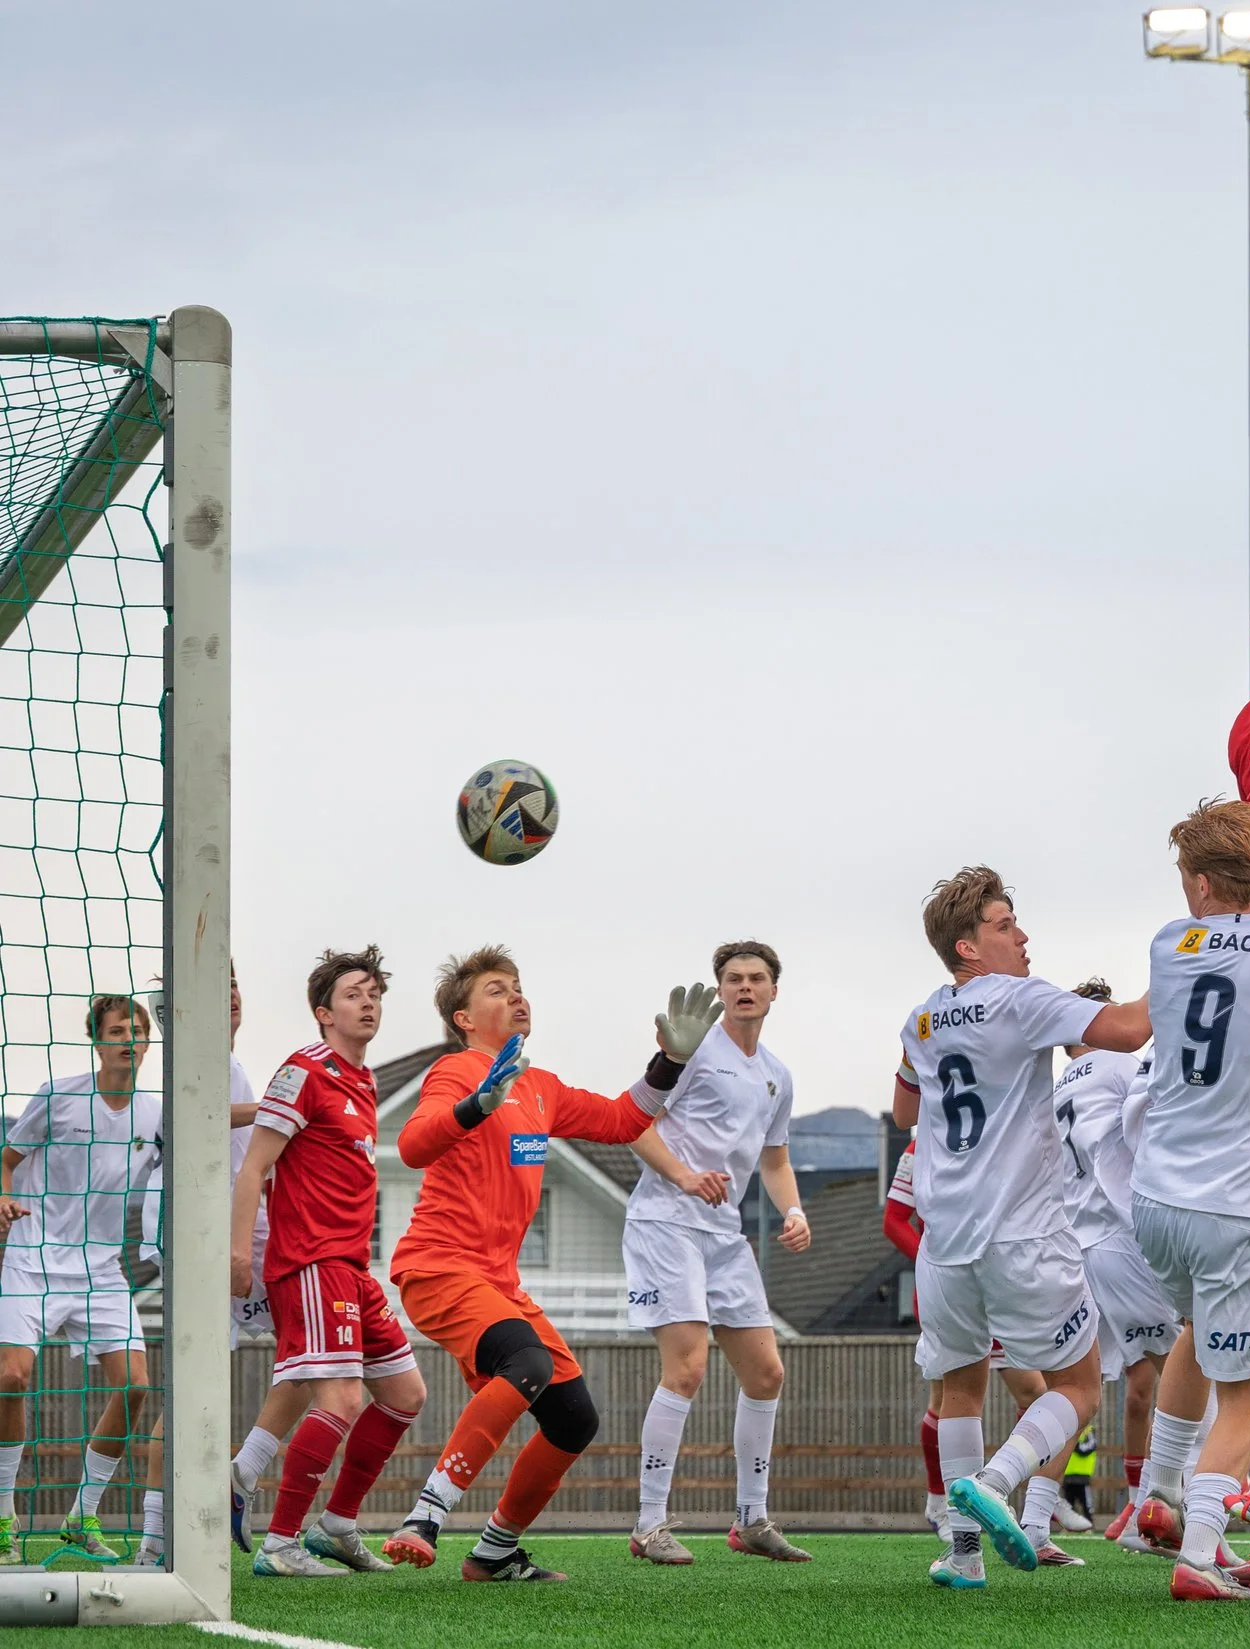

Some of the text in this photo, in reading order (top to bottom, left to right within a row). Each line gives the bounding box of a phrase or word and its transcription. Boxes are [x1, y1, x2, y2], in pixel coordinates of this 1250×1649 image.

[932, 1004, 985, 1031] BACKE
[1181, 973, 1236, 1088] 9
[1054, 1062, 1093, 1093] BACKE
[937, 1053, 987, 1153] 6
[513, 1138, 548, 1154] SpareBan
[242, 1299, 270, 1320] SAT
[628, 1289, 659, 1306] SATS
[336, 1325, 353, 1346] 14
[1054, 1300, 1090, 1350] SATS
[1124, 1323, 1166, 1344] SATS
